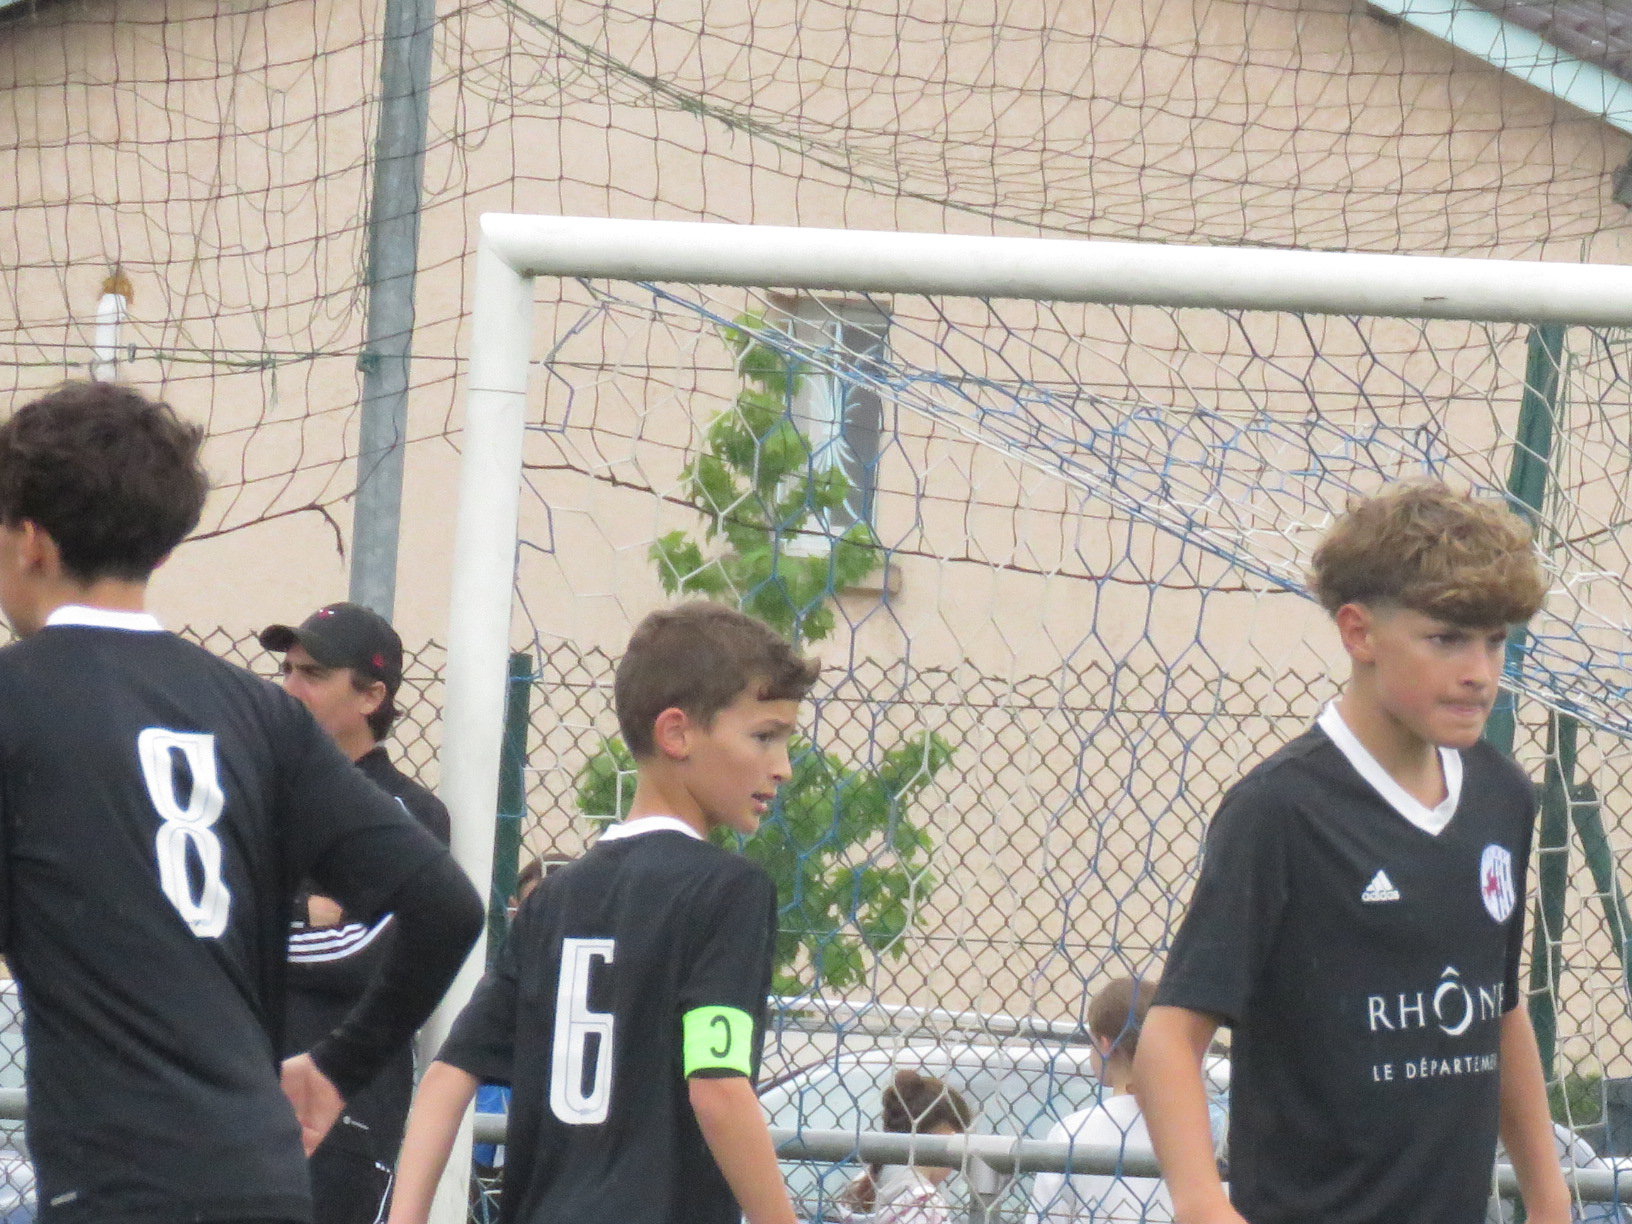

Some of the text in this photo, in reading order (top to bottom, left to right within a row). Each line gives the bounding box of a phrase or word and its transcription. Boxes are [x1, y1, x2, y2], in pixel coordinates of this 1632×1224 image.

[138, 726, 231, 939] 8
[550, 937, 616, 1125] 6
[1373, 1063, 1394, 1082] LE
